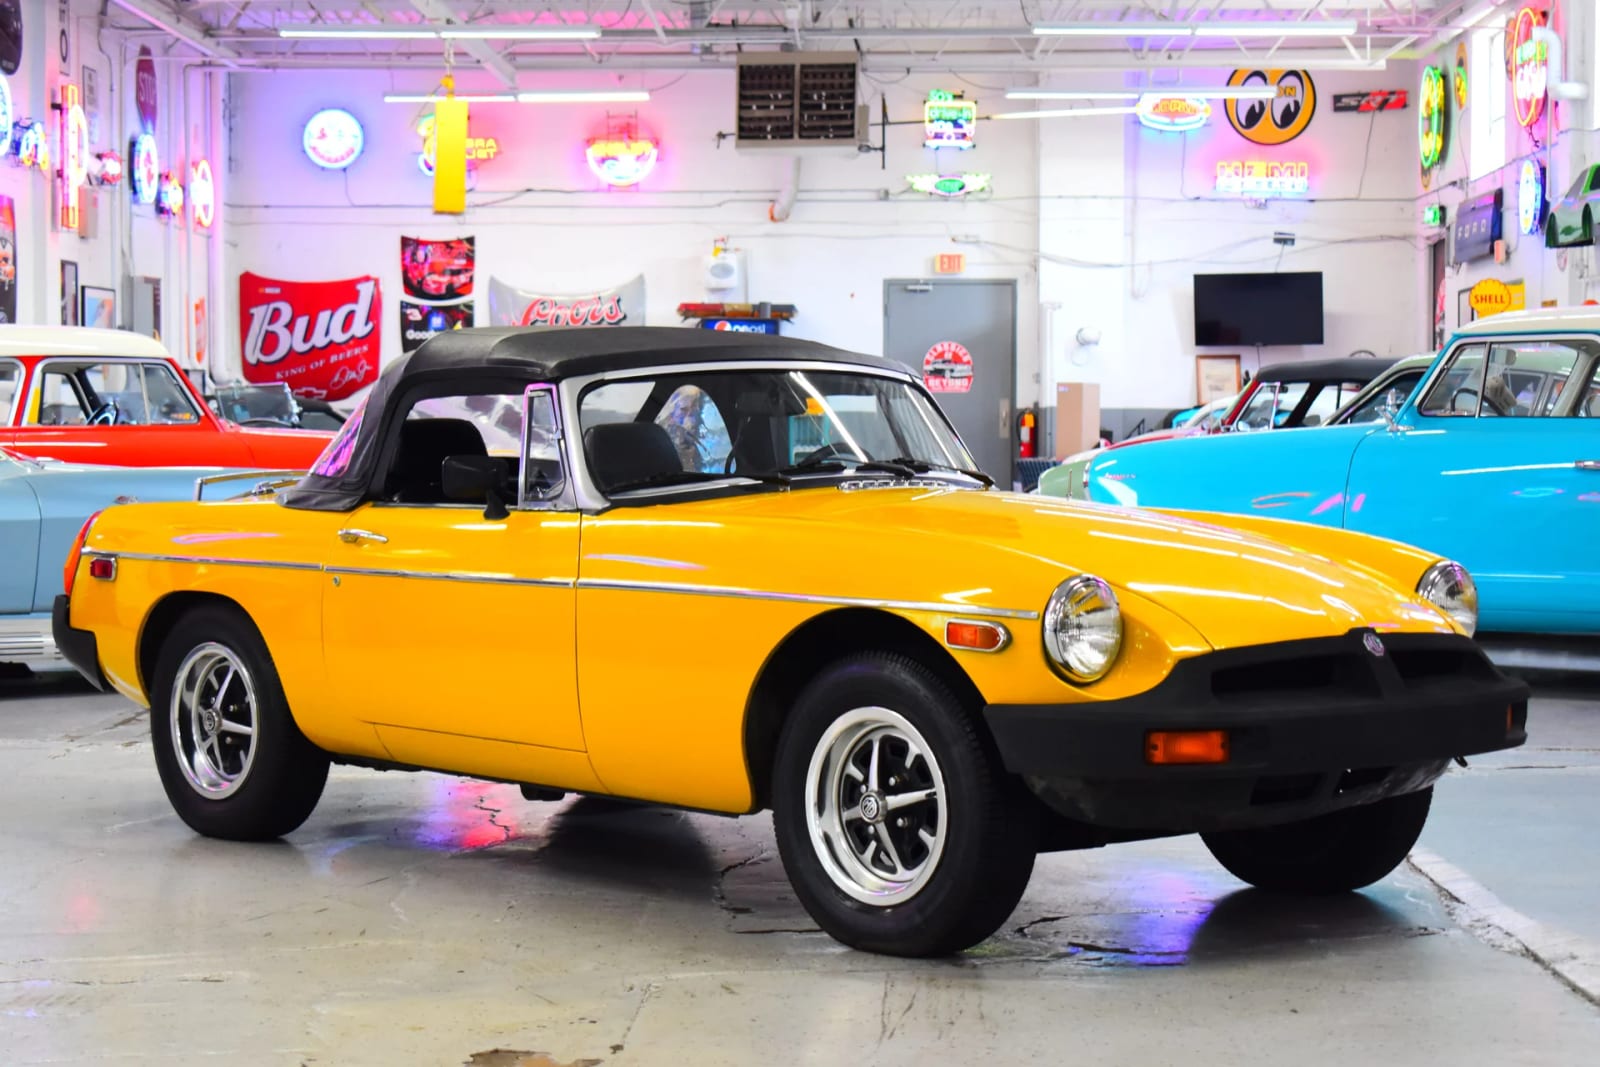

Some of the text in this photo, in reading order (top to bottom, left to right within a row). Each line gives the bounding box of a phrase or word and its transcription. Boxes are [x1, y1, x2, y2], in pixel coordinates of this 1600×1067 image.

[1276, 86, 1297, 98] ON
[1216, 161, 1309, 178] HEMI
[1457, 218, 1487, 241] FORD
[940, 254, 960, 272] EXIT
[1474, 294, 1505, 305] SHELL
[513, 295, 626, 326] Coors
[244, 280, 376, 366] Bud
[276, 344, 369, 380] KING OF BEERS
[928, 377, 969, 386] BEYOND
